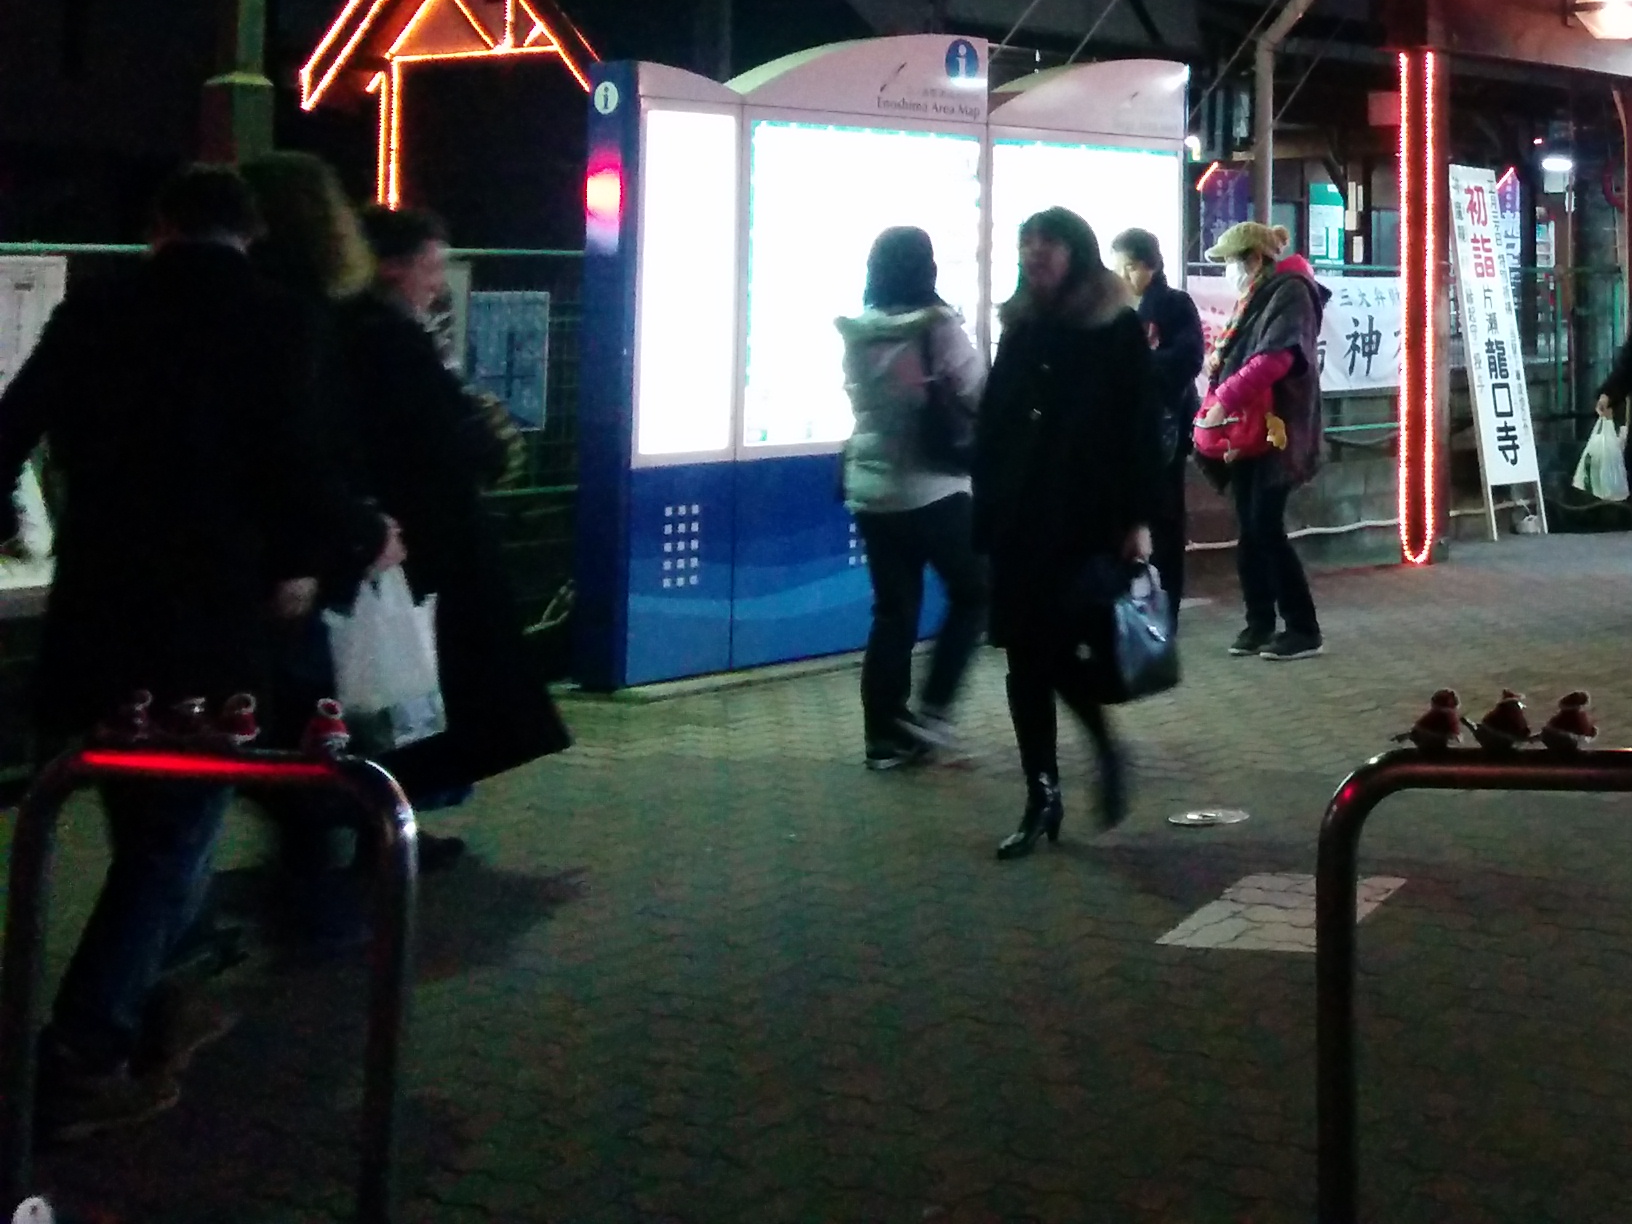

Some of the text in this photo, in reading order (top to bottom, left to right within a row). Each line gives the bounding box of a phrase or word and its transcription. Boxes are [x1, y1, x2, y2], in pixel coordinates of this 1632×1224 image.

[877, 96, 980, 120] Enoshima Area Map
[1464, 185, 1496, 278] 初詣
[1484, 338, 1521, 467] 龍口寺
